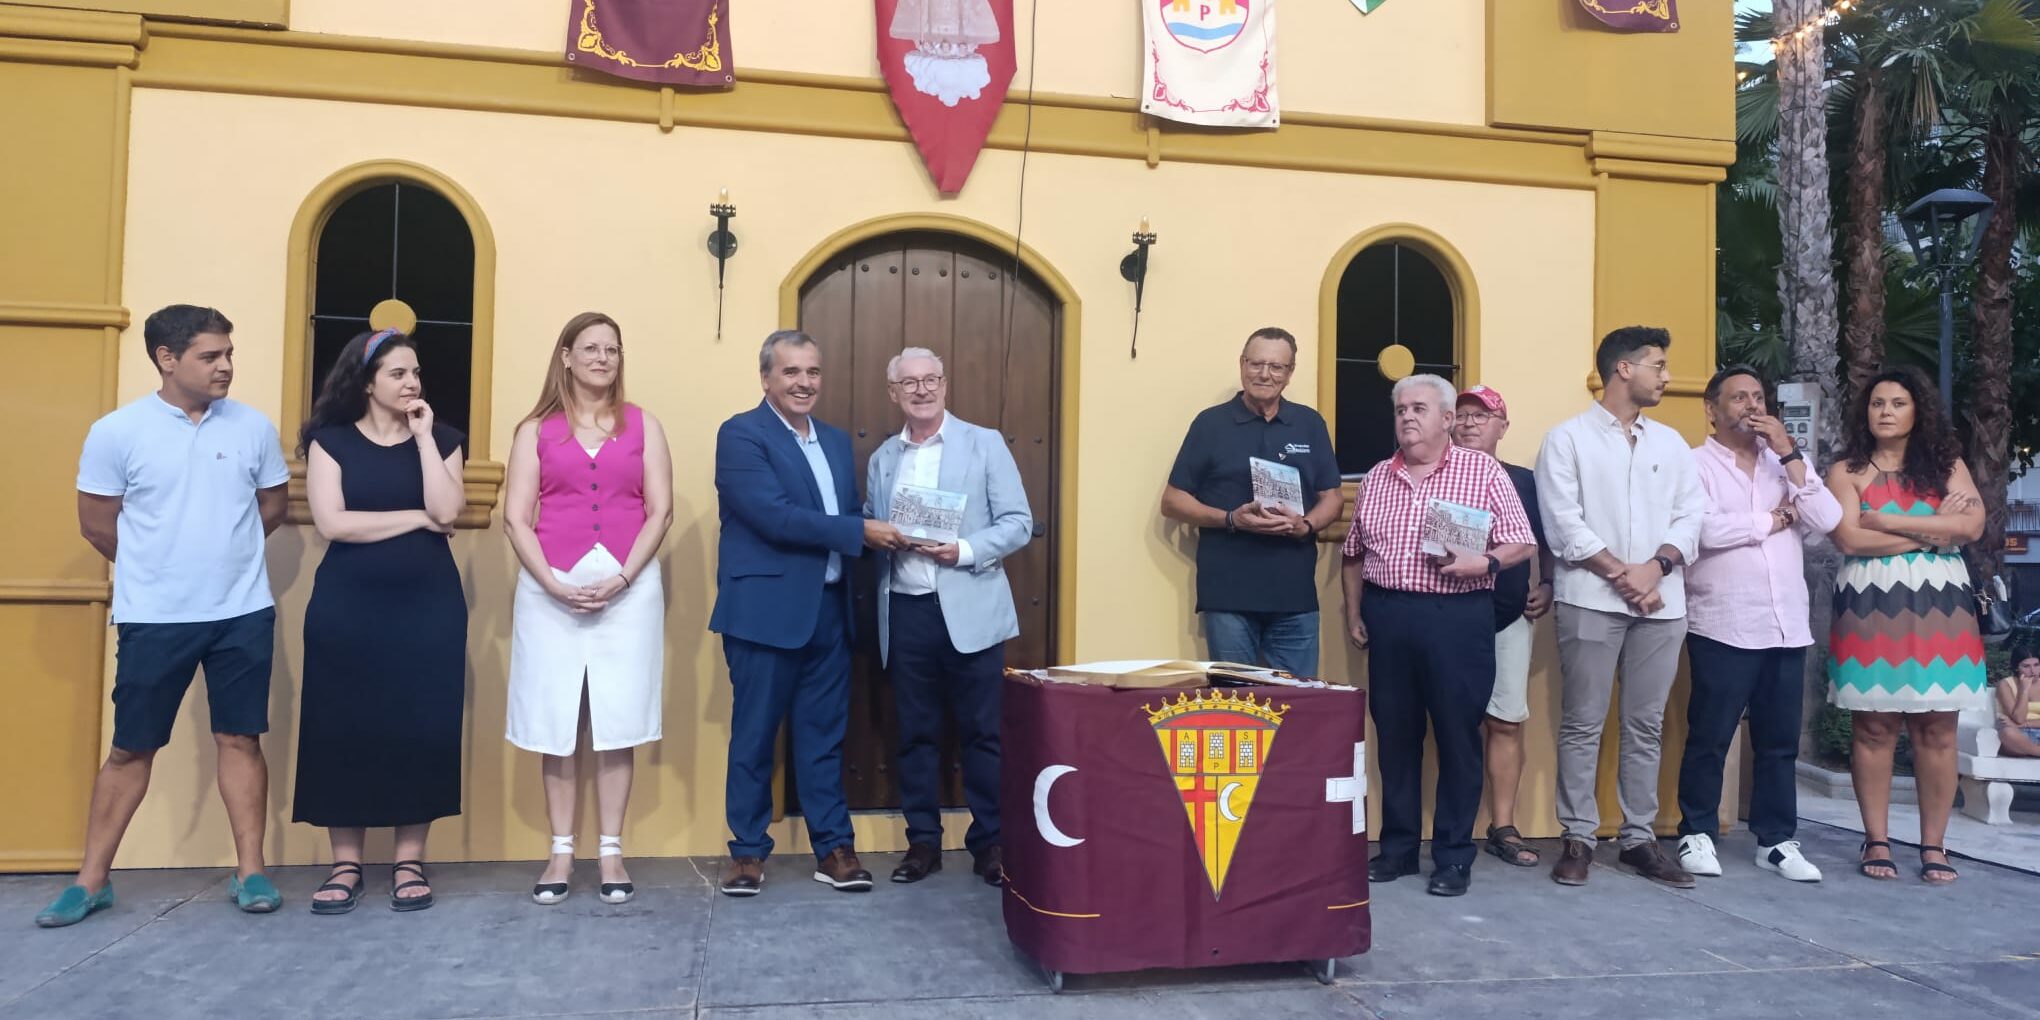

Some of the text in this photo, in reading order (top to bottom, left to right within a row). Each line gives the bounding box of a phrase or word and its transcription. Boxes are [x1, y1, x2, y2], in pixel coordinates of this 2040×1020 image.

[1200, 4, 1211, 21] P
[1183, 731, 1190, 741] A
[1243, 731, 1249, 740] S
[1213, 761, 1220, 770] P
